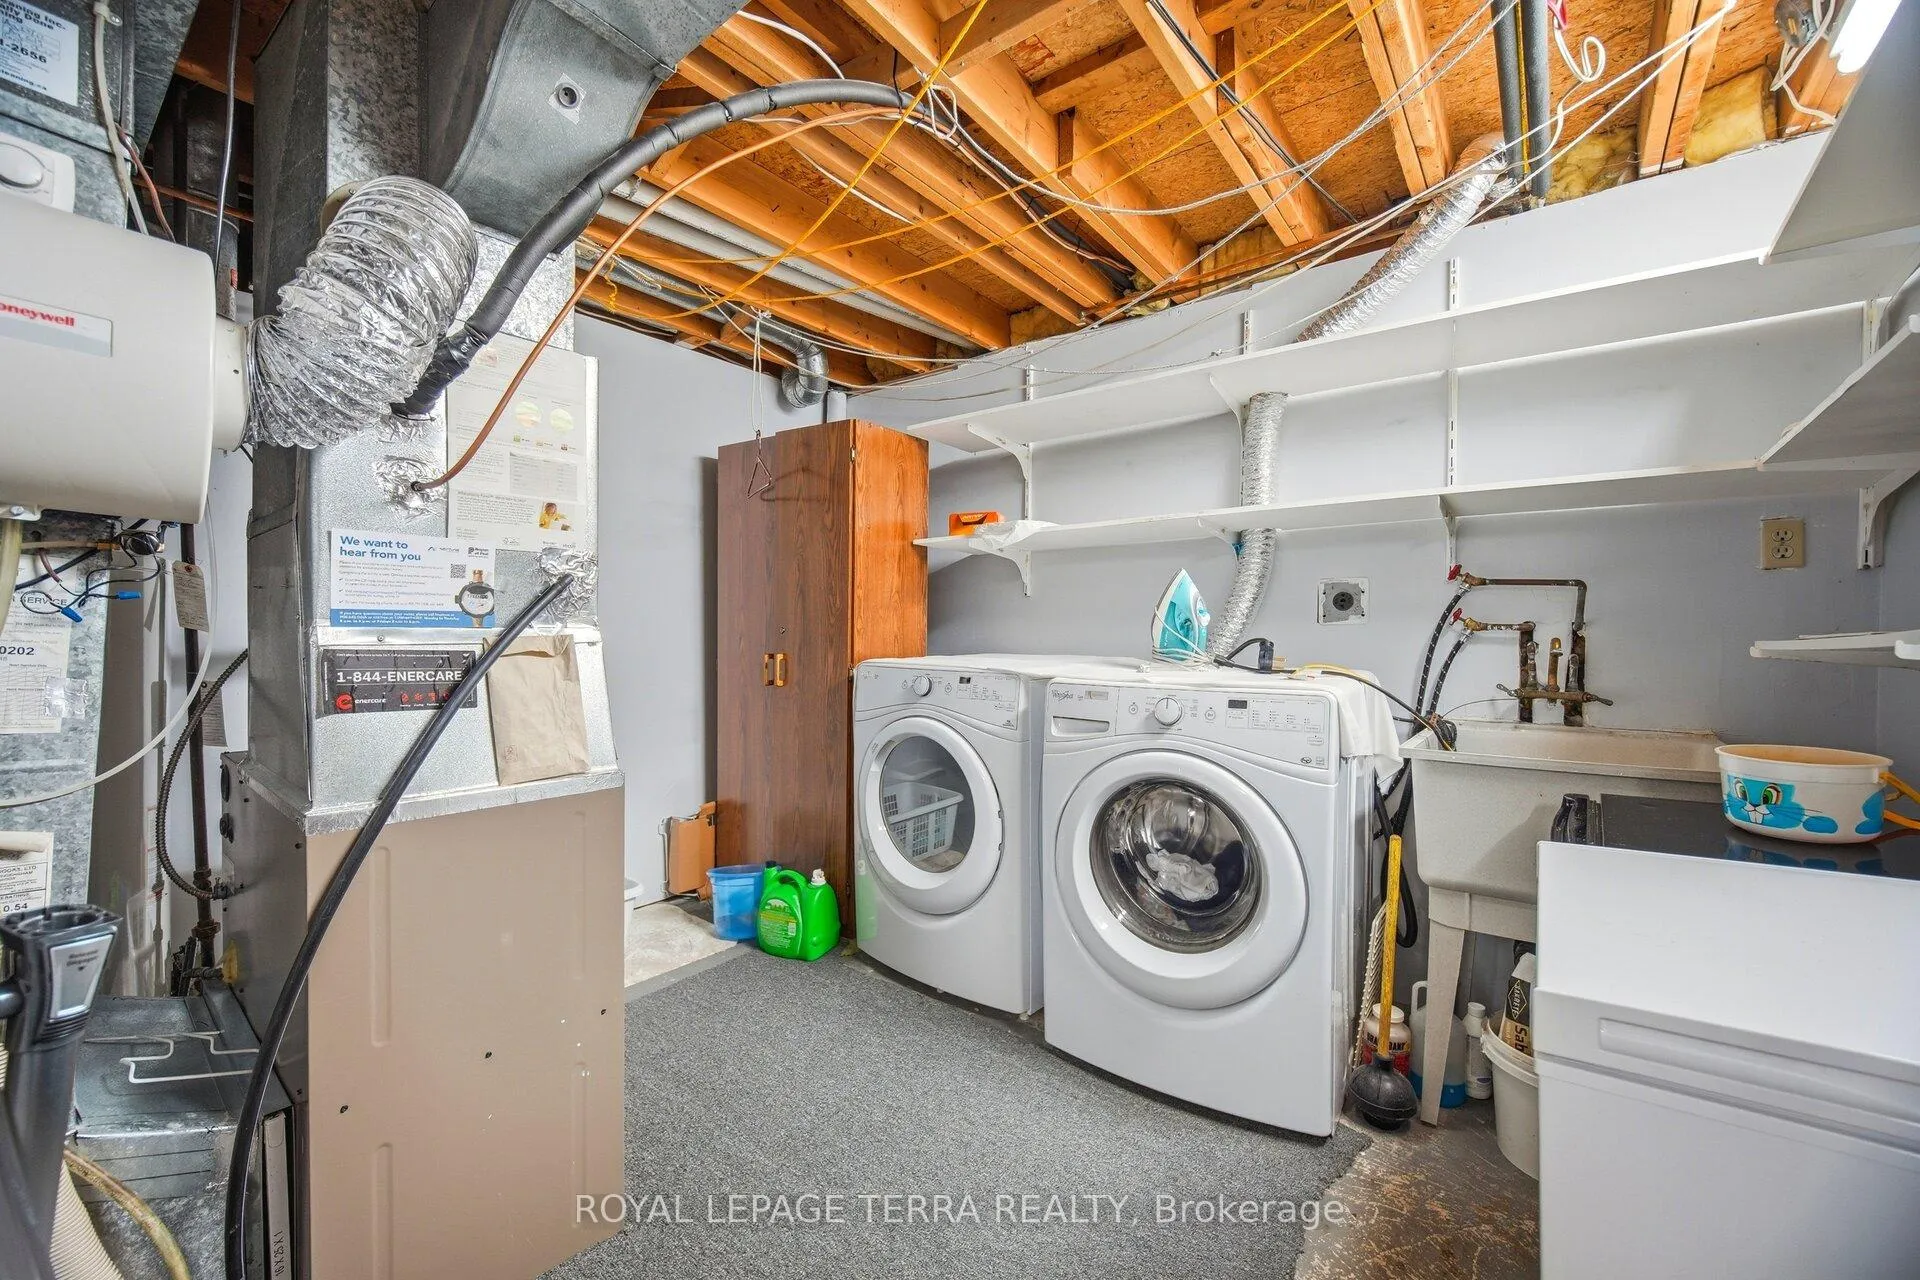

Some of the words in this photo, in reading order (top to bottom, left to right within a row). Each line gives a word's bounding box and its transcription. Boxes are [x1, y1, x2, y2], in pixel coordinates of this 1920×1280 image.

[24, 13, 54, 30] Done
[45, 15, 66, 30] Inc.
[340, 535, 360, 546] We
[364, 538, 392, 549] want
[396, 540, 408, 549] to
[339, 546, 366, 557] hear
[369, 548, 397, 560] from
[400, 552, 421, 562] you
[337, 671, 462, 682] 1-844-ENERCARE
[3, 902, 28, 913] 0.54
